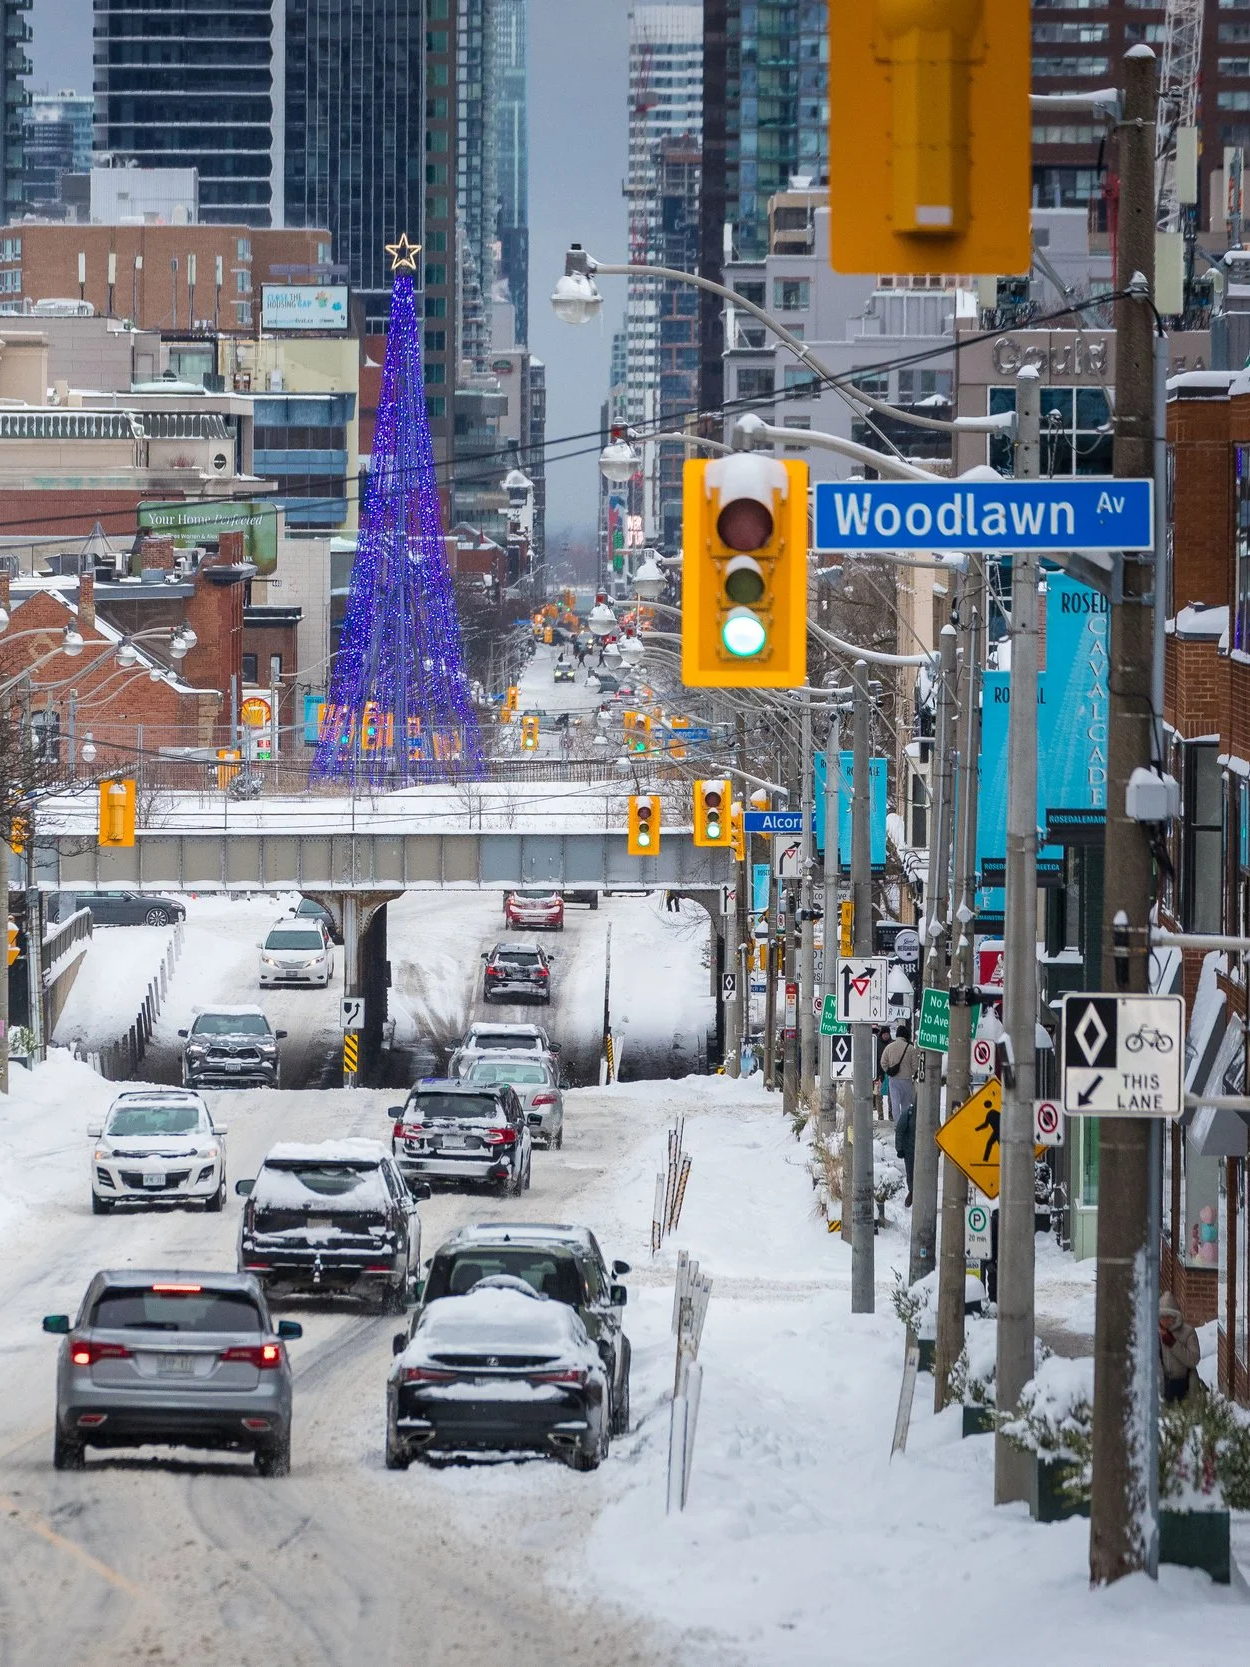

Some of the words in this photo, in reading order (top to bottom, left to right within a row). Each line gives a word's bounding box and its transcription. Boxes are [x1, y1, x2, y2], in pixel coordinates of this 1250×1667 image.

[267, 300, 296, 309] HOUSING
[993, 337, 1107, 376] Gould
[834, 493, 1075, 536] Woodlawn
[1096, 491, 1125, 514] Av
[149, 513, 175, 525] Your
[178, 513, 211, 525] Home
[214, 513, 264, 528] Perfected
[1061, 592, 1108, 614] ROSED
[1087, 617, 1108, 806] CAVALCADE
[930, 996, 942, 1008] No
[825, 1011, 833, 1019] to
[925, 1012, 932, 1023] to
[822, 1023, 837, 1032] from
[920, 1030, 937, 1042] from
[1122, 1073, 1160, 1090] THIS
[1117, 1094, 1163, 1110] LANE
[968, 1234, 976, 1242] 20
